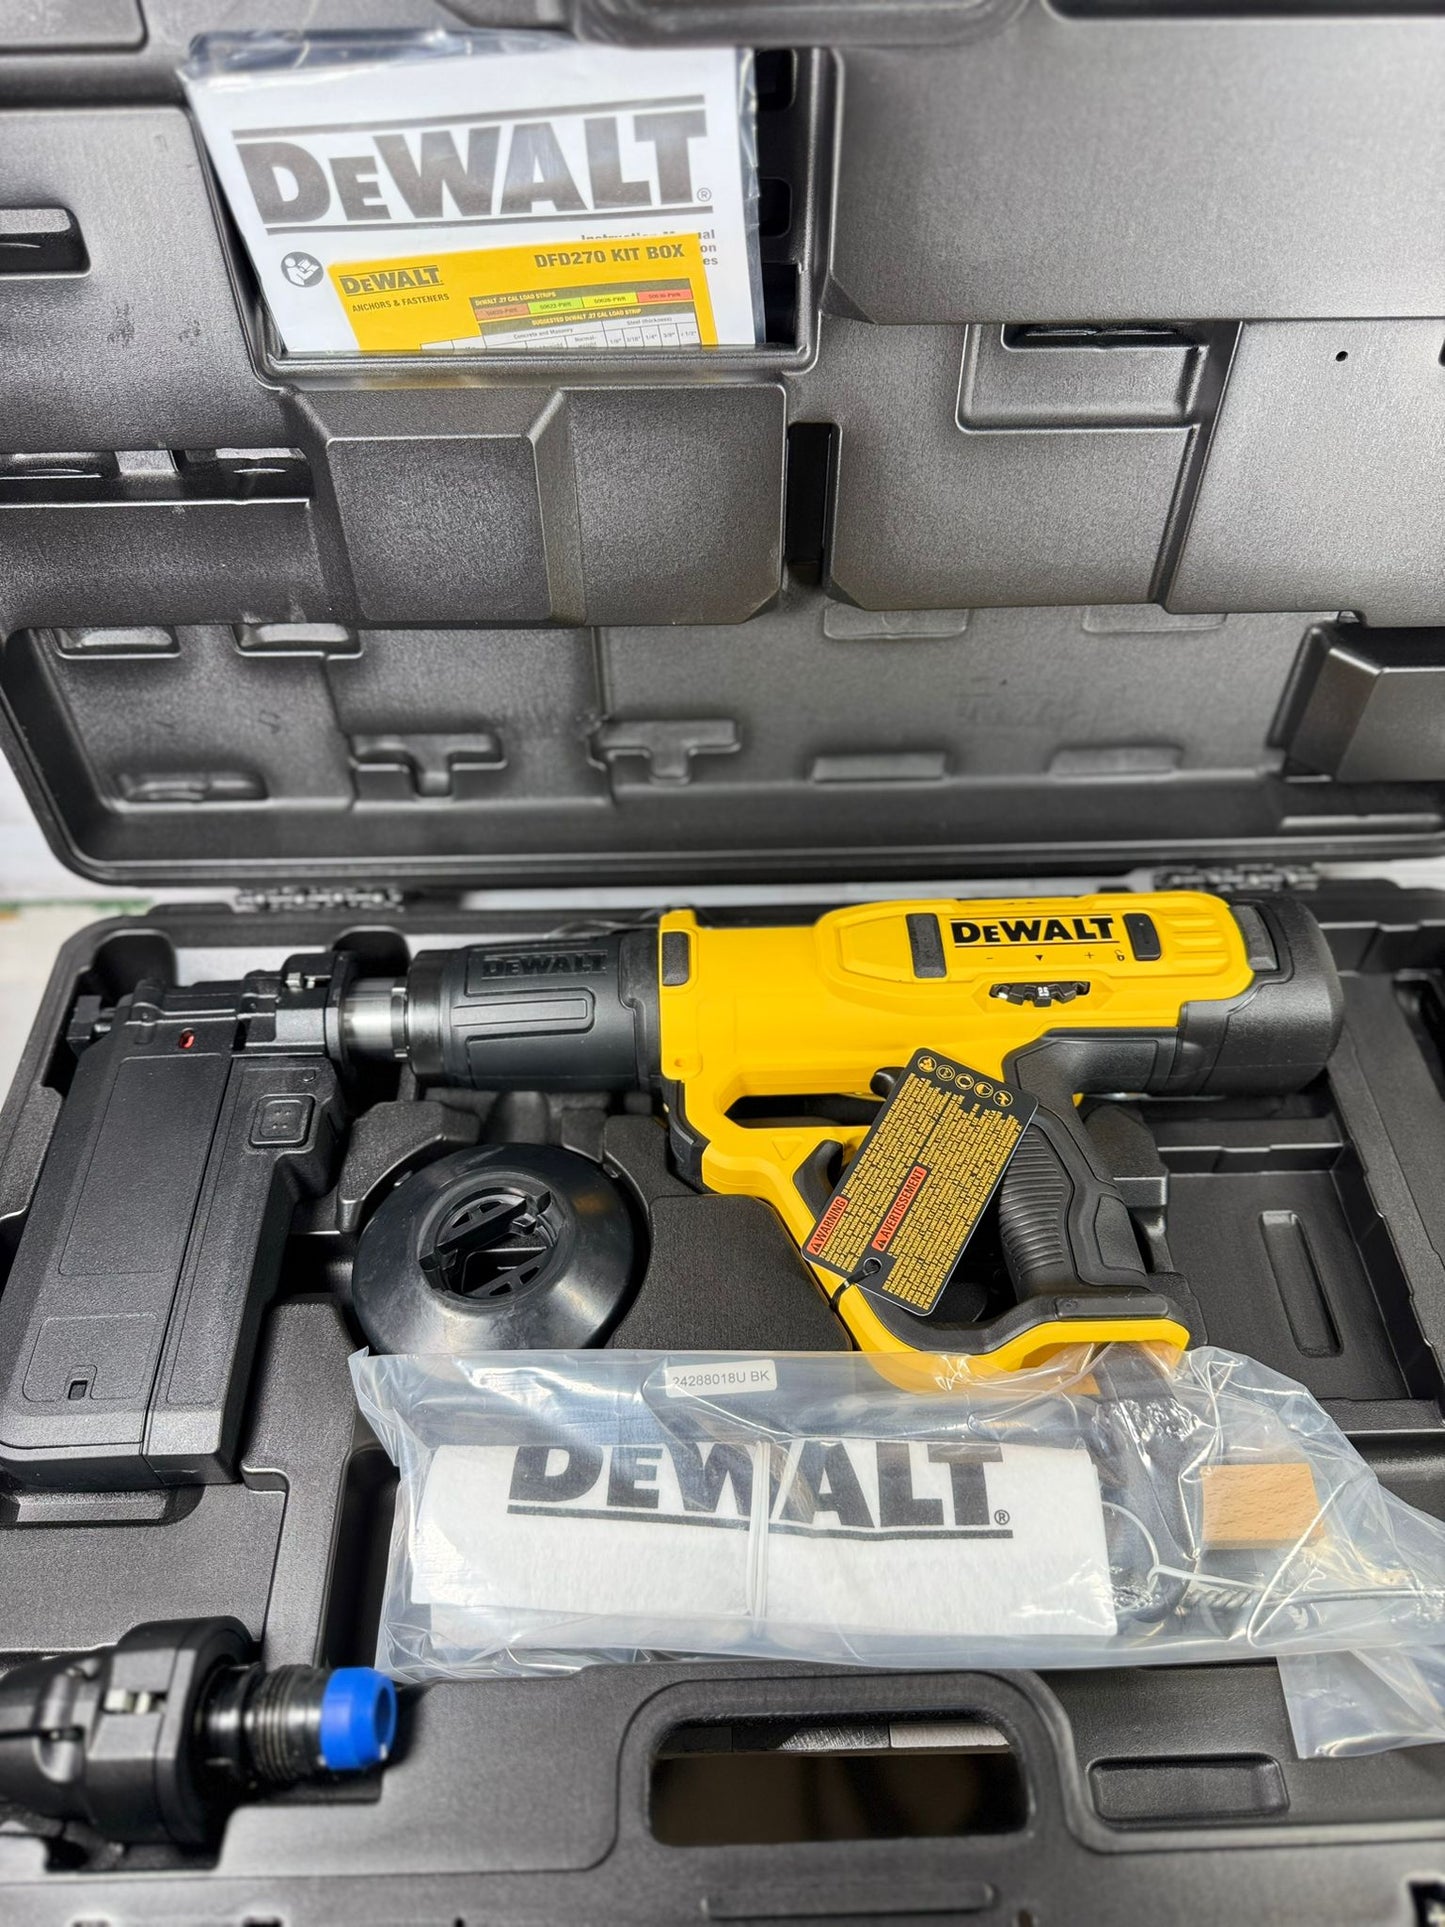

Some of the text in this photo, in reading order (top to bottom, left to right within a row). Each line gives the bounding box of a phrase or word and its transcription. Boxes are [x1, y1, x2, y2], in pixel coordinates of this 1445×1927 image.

[534, 250, 606, 268] DFD270
[611, 247, 640, 262] KIT
[645, 243, 685, 260] BOX
[352, 293, 450, 312] ANCHORS & FASTENERS
[507, 295, 518, 303] CAL
[518, 293, 535, 301] LOAD
[536, 291, 556, 300] STRIPS
[531, 316, 564, 326] SUGGESTED
[597, 311, 607, 319] CAL
[624, 308, 641, 316] STRIP
[513, 331, 539, 340] Concrete
[882, 1168, 924, 1239] AVERTISSEMENT
[816, 1198, 846, 1243] WARNING
[750, 1370, 770, 1382] BK
